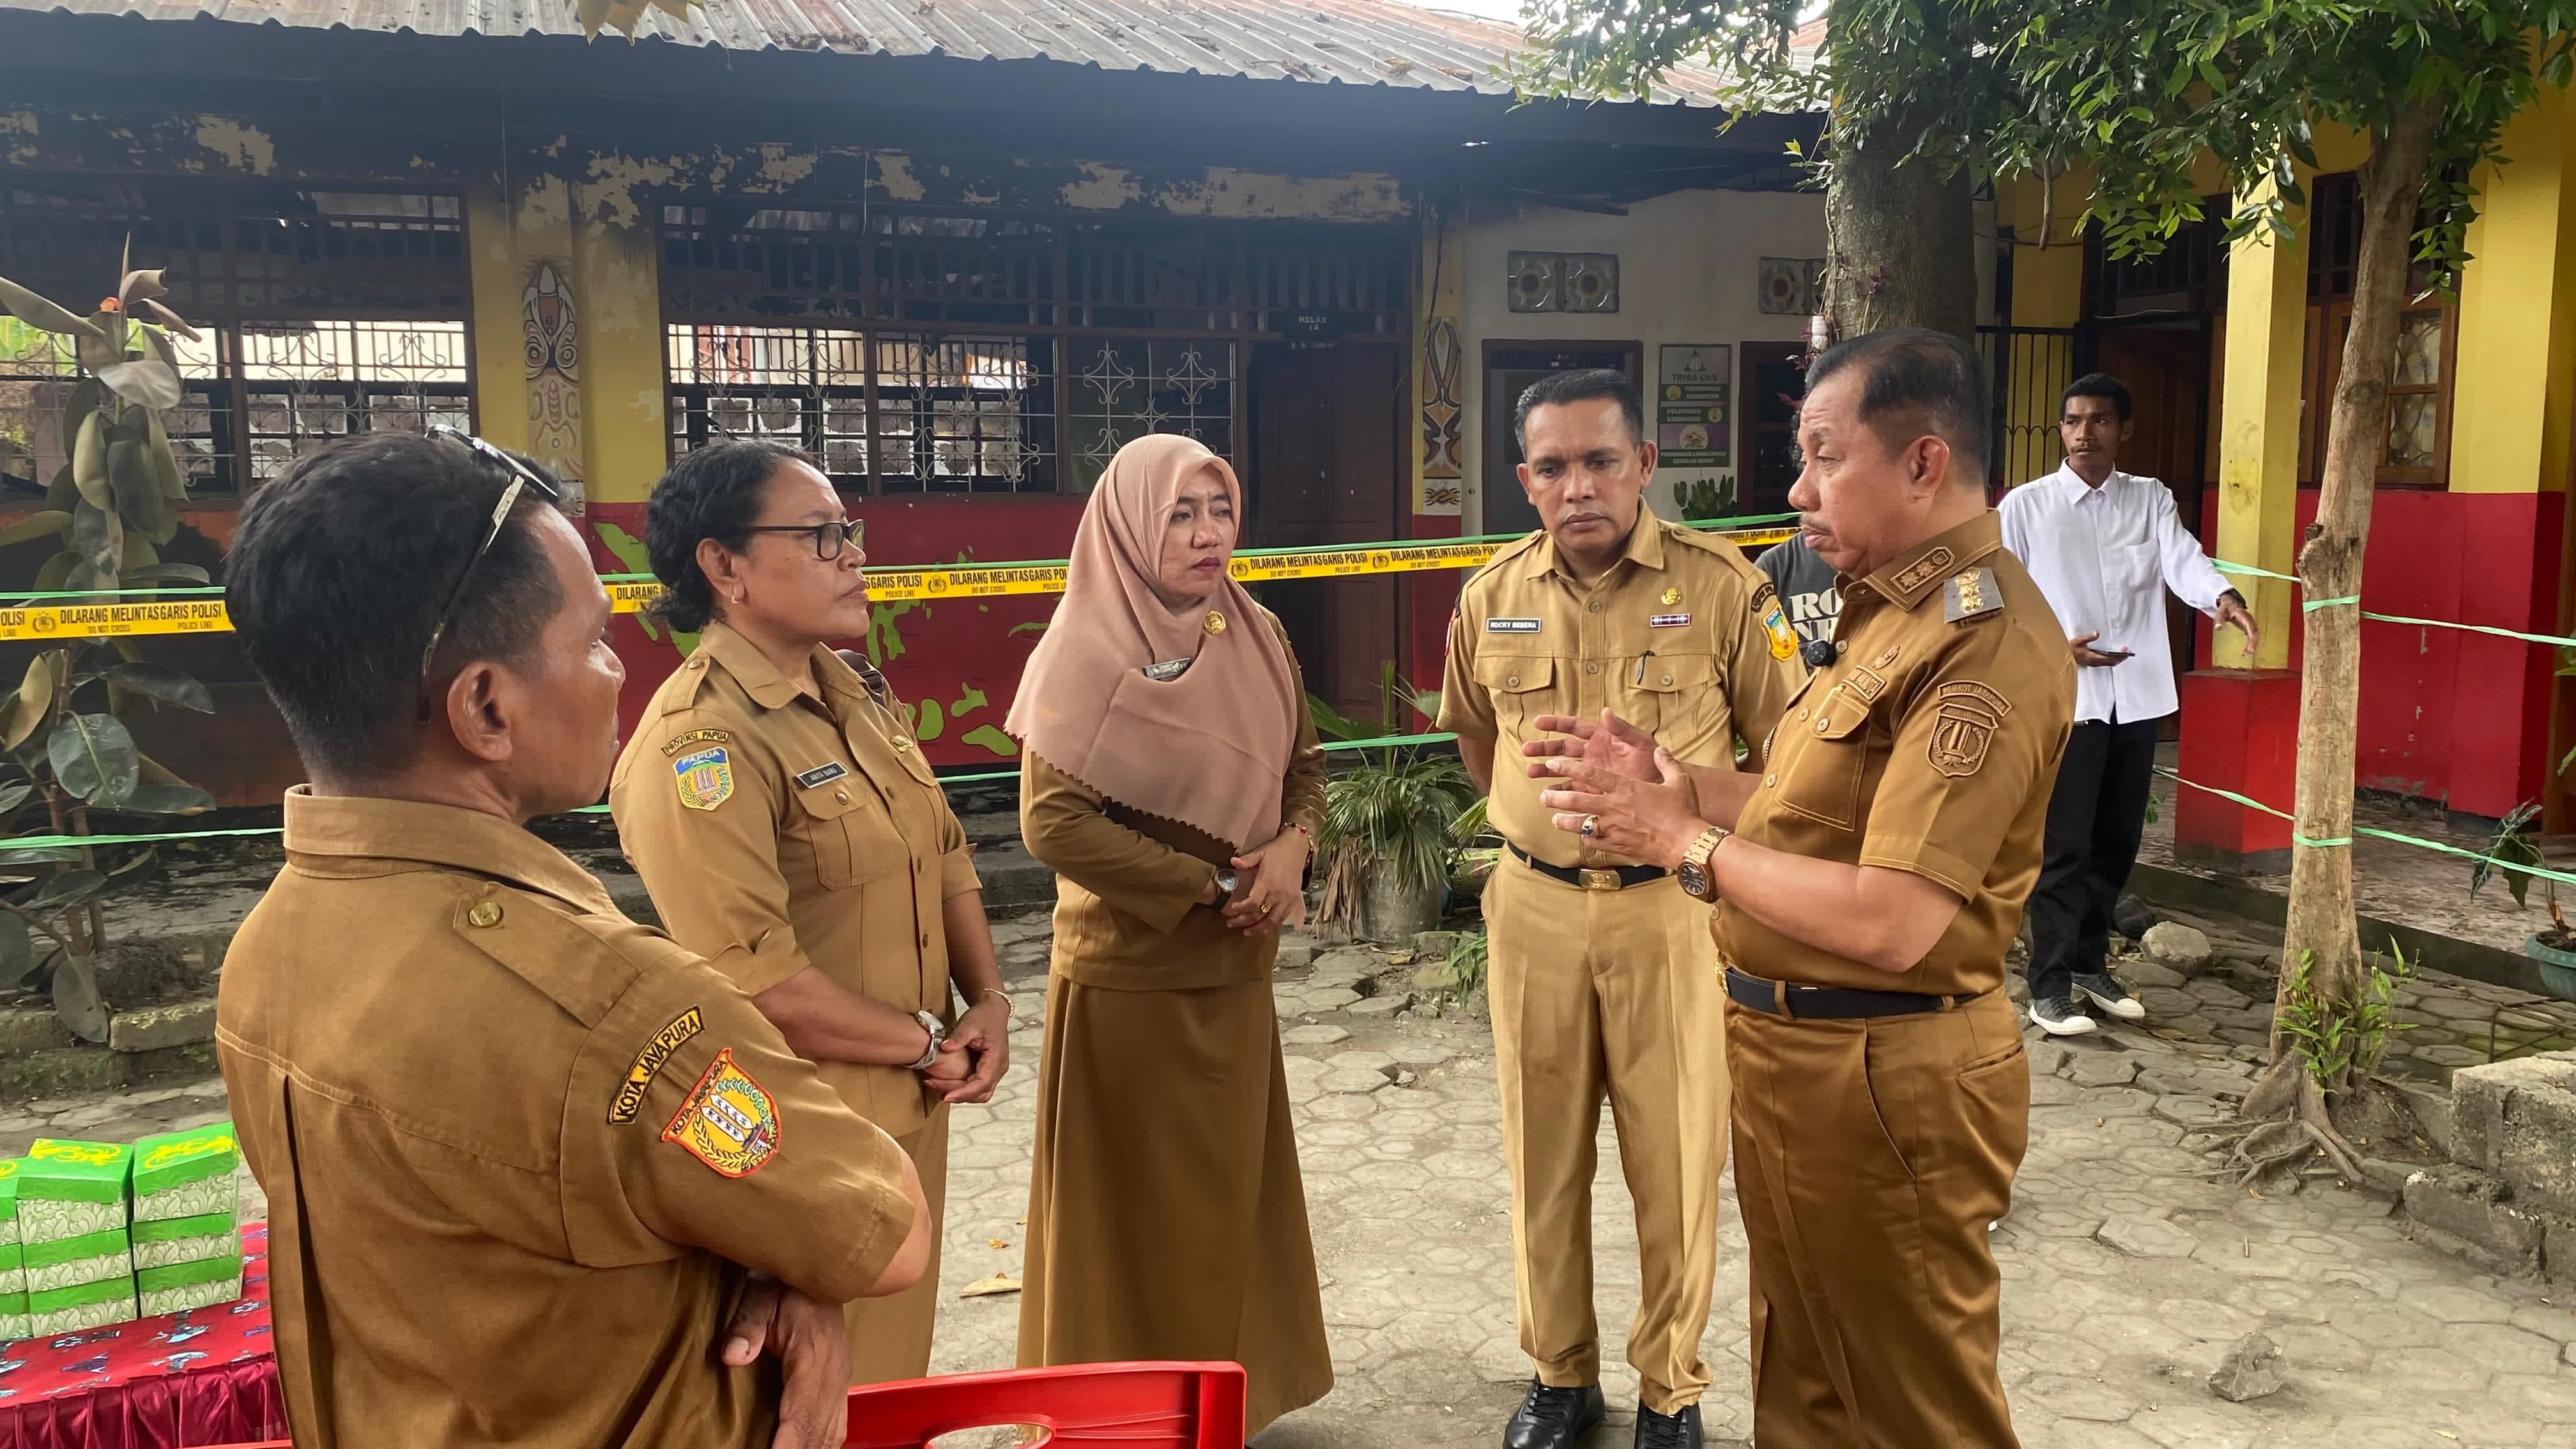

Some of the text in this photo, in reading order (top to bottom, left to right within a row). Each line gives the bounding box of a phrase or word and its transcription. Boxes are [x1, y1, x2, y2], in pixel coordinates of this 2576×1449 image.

[1671, 373, 1698, 381] TRIAS
[1250, 553, 1368, 569] DILARANG MELINTAS GARIS POLISI
[1390, 545, 1503, 561] DILARANG MELINTAS GARIS POLI
[871, 576, 894, 589] GARIS
[897, 574, 923, 588] POLISI
[950, 568, 1068, 585] DILARANG MELINTAS GARIS POL
[617, 585, 659, 599] DILARANG
[1, 611, 25, 625] OLISI
[60, 603, 221, 624] DILARANG MELINTAS GARIS POLISI
[111, 624, 130, 633] CROSS
[178, 620, 213, 630] POLICE LINE
[666, 731, 726, 754] PROVINSI PAPUA
[682, 749, 721, 765] PAPUA
[615, 1015, 699, 1117] KOTA JAYAPURA
[671, 1108, 694, 1135] KOTA
